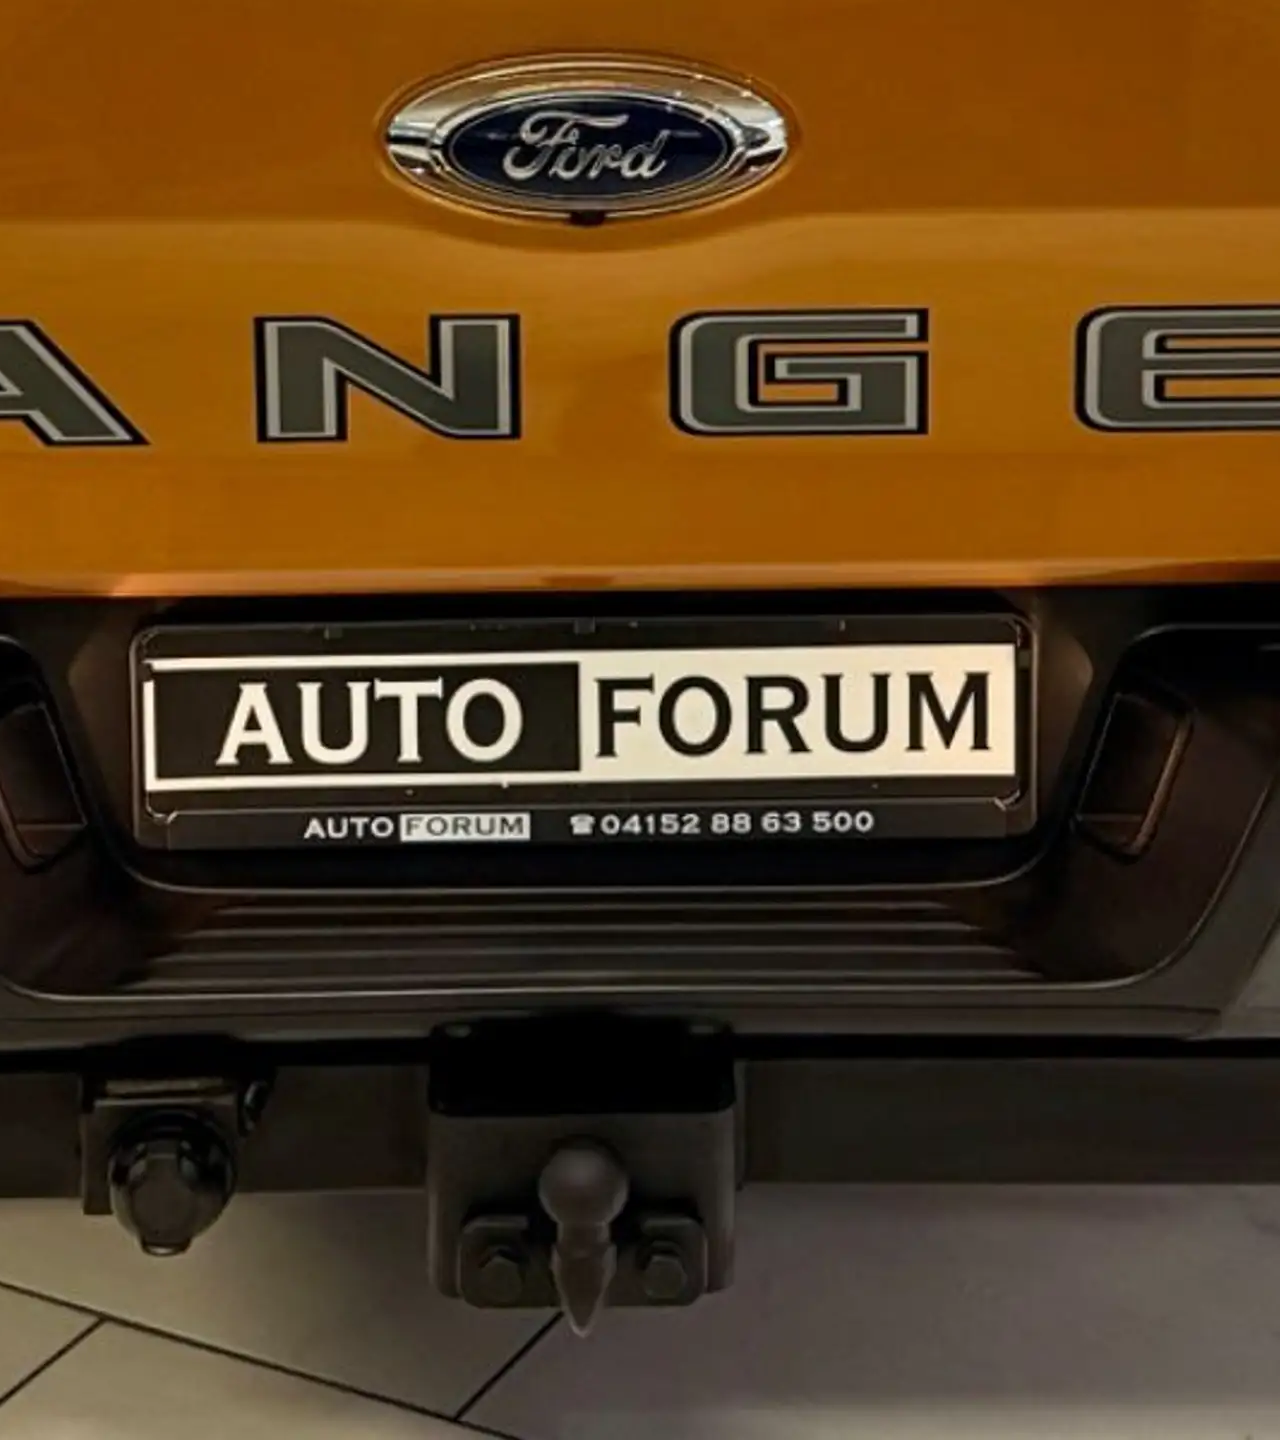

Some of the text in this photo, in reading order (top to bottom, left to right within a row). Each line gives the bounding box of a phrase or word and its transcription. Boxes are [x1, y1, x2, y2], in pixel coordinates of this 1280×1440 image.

[502, 109, 670, 181] Ford
[215, 671, 992, 766] AUTO FORUM
[304, 811, 875, 840] AUTO FORUM 04152 88 63 500
